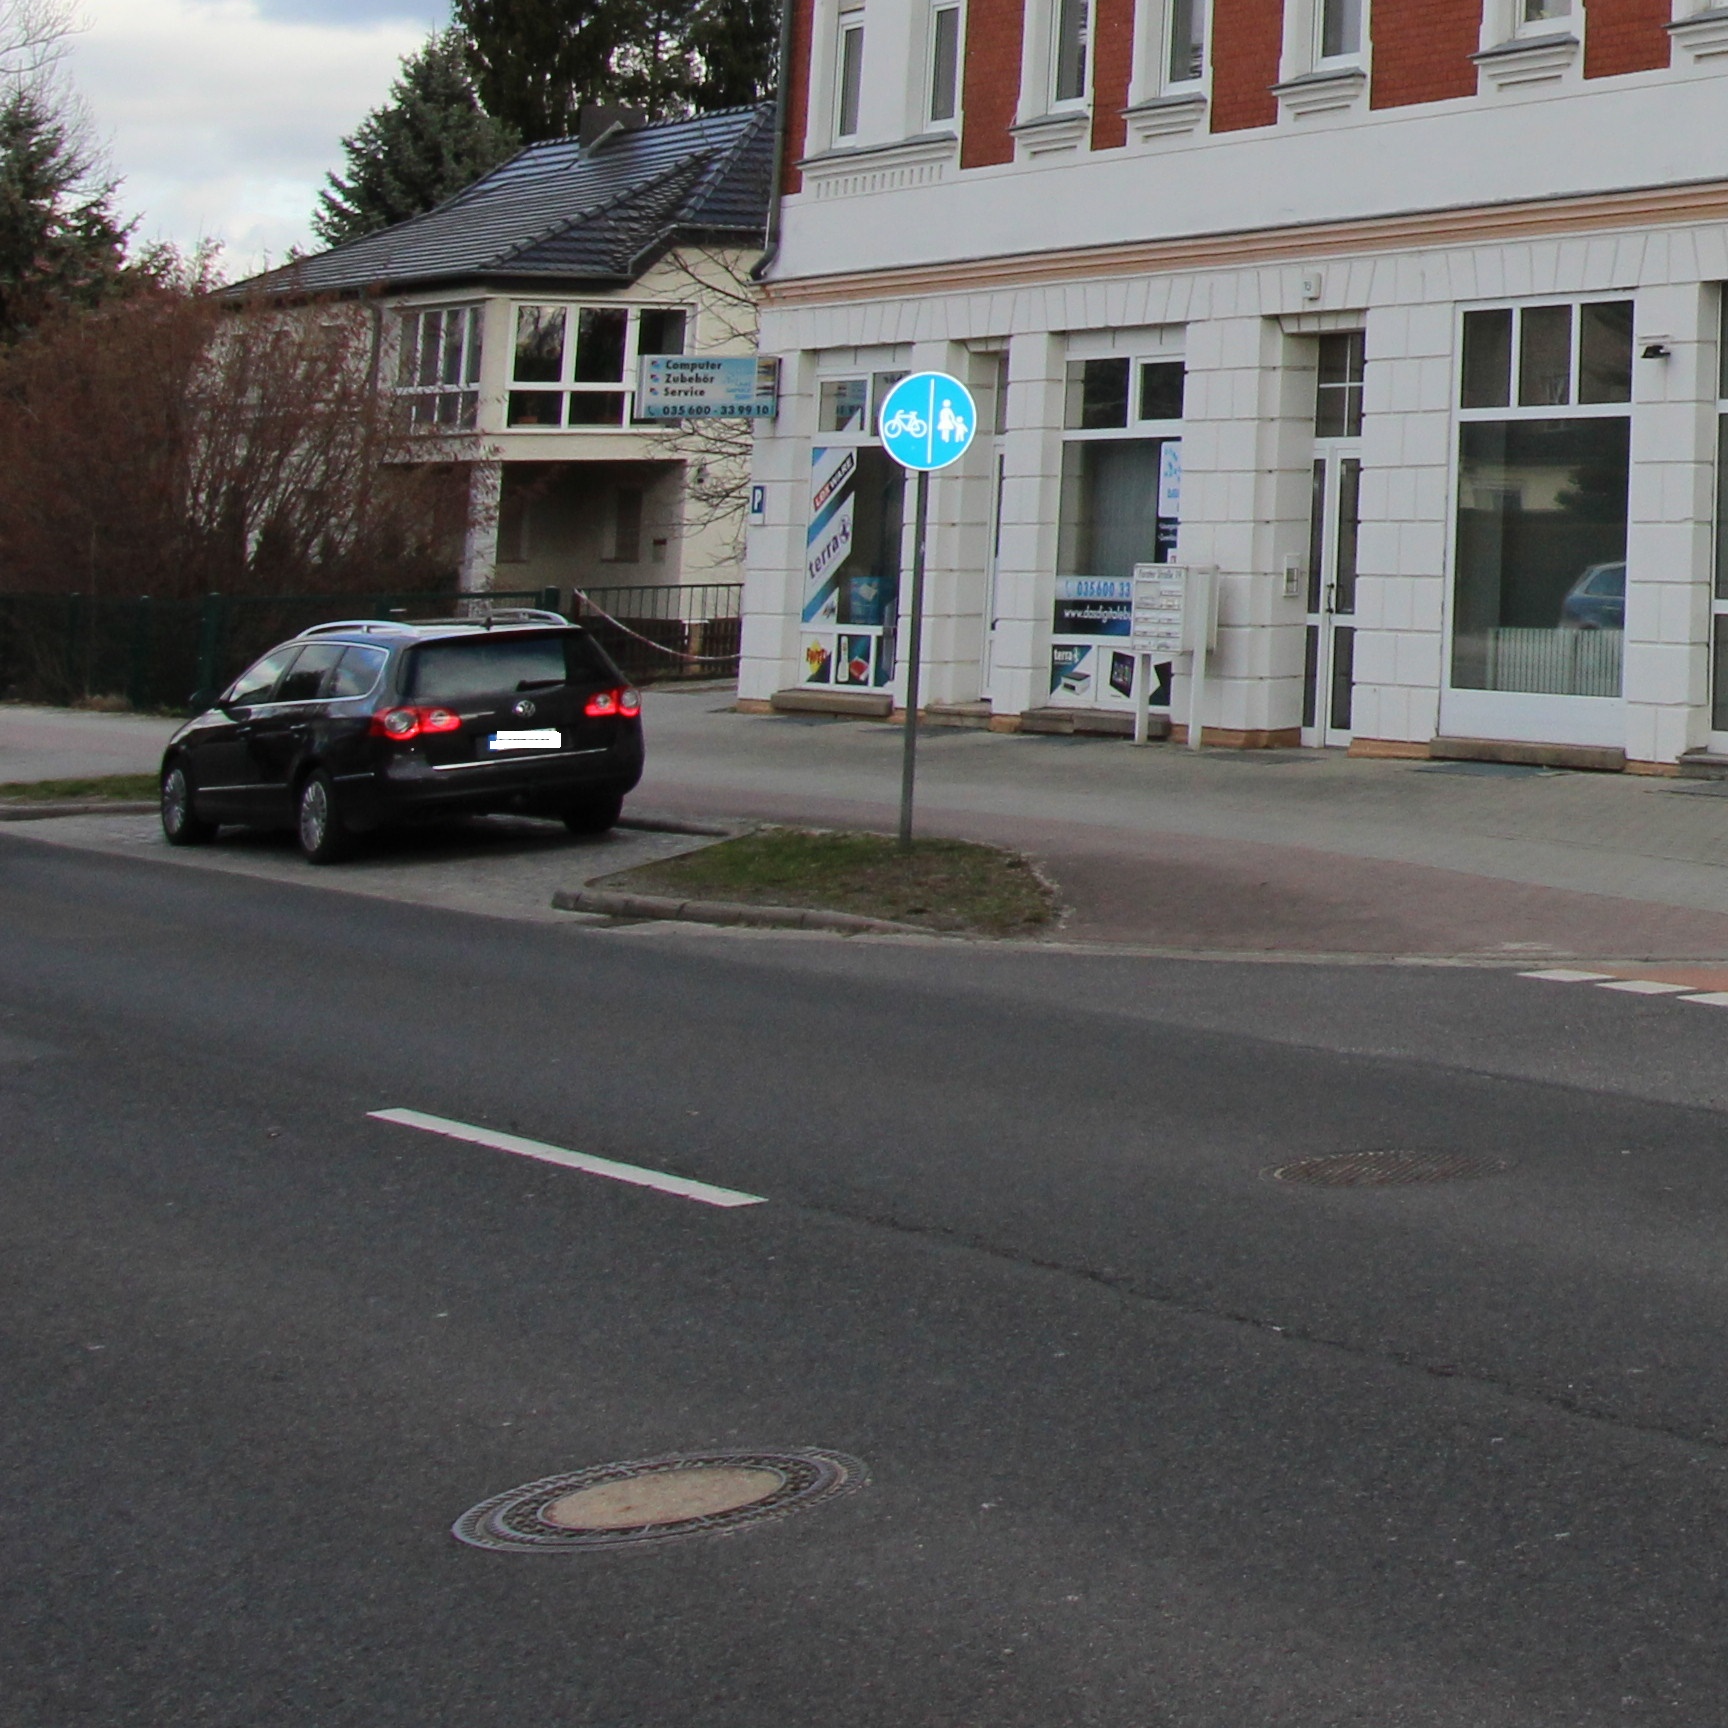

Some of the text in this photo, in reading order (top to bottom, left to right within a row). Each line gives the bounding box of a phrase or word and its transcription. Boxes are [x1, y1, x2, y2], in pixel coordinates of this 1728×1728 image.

[665, 359, 722, 372] Computer
[664, 373, 715, 384] Zubehör
[663, 387, 706, 397] Service
[663, 405, 684, 416] 035
[688, 405, 711, 416] 600
[720, 405, 735, 416] 33
[738, 405, 752, 416] 99
[756, 404, 770, 415] 10
[754, 488, 762, 511] P
[808, 535, 839, 578] terra
